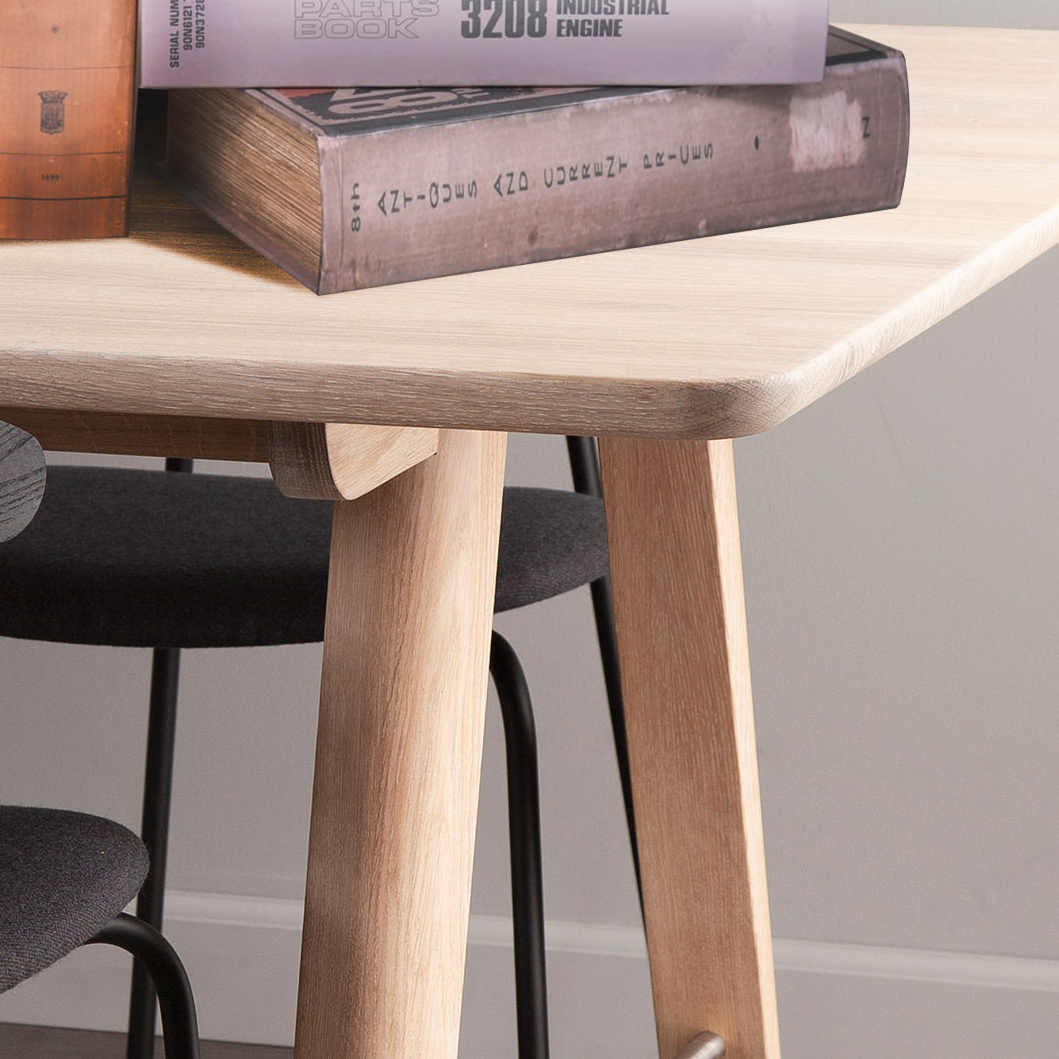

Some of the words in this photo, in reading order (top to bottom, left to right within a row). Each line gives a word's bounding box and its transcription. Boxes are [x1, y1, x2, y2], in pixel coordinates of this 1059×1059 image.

[183, 5, 193, 51] 90N6121
[294, 18, 419, 39] BOOK
[556, 19, 623, 37] ENGINE
[169, 30, 180, 68] SERIAL
[377, 180, 478, 216] ANTIQUES
[493, 171, 528, 197] AND
[544, 155, 628, 188] CURRENT
[643, 142, 714, 170] PRICES
